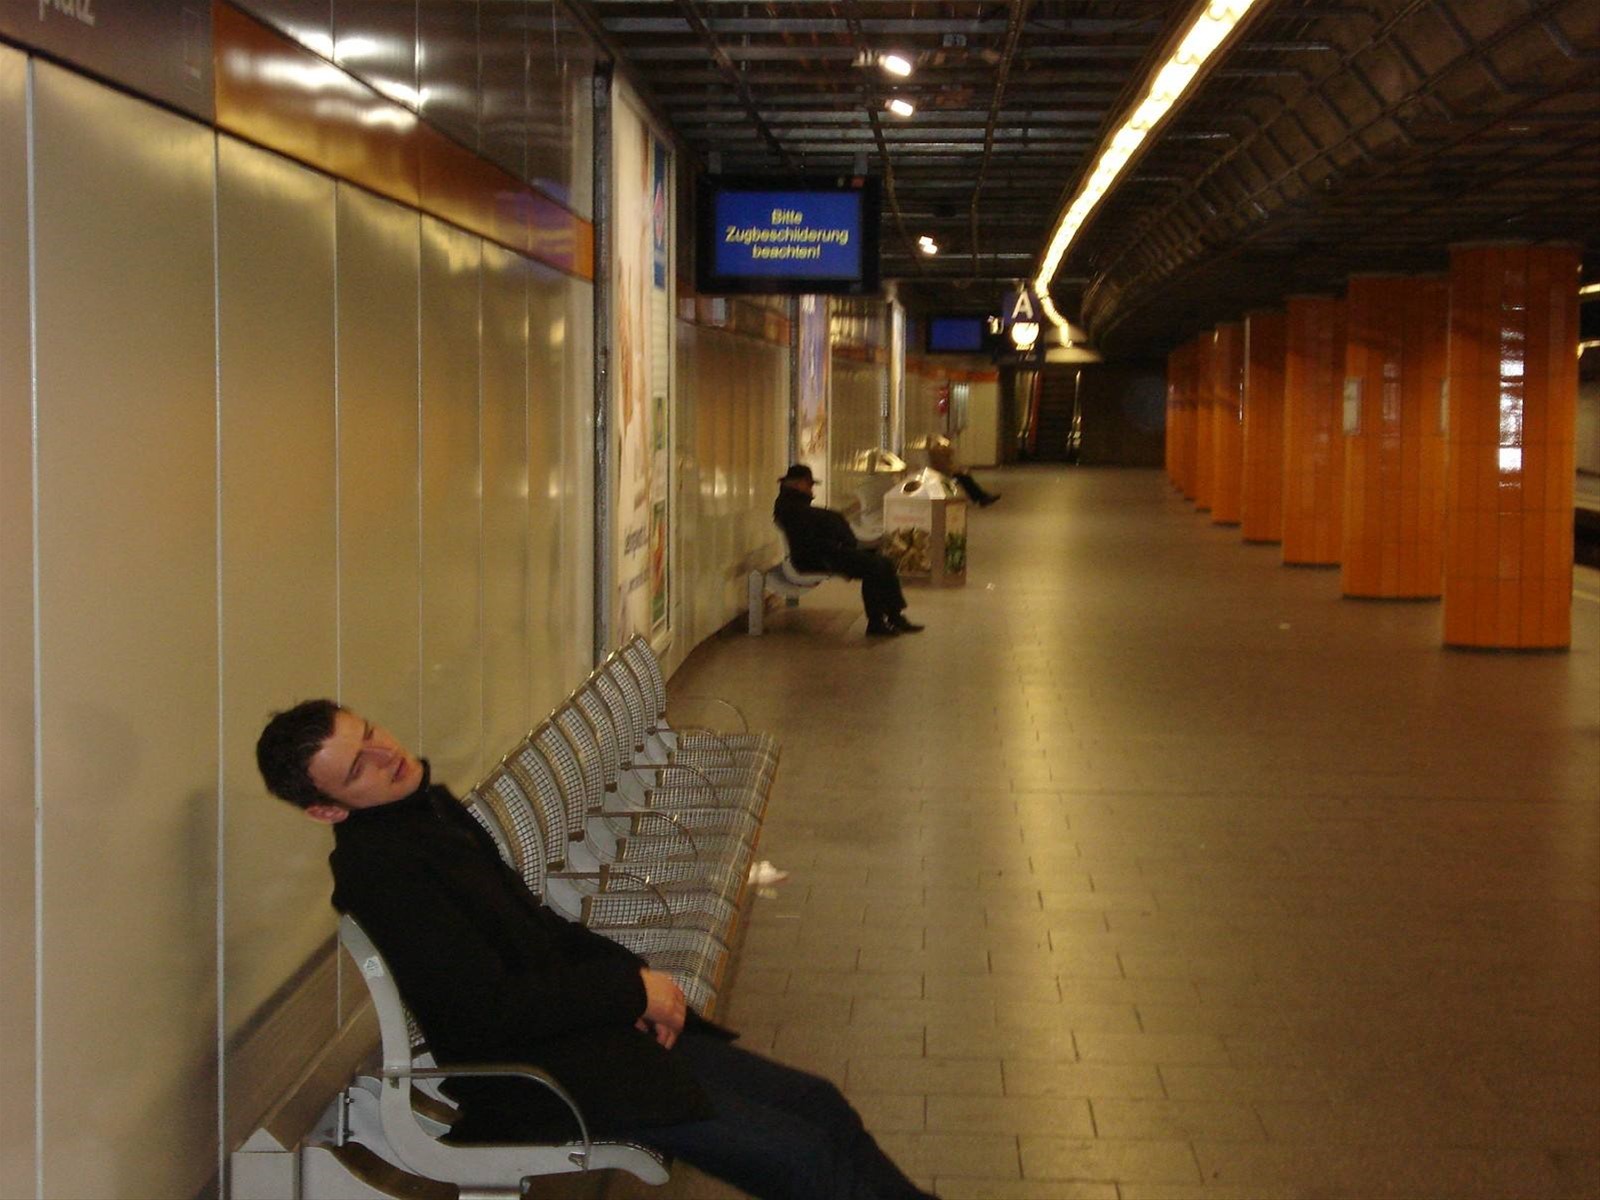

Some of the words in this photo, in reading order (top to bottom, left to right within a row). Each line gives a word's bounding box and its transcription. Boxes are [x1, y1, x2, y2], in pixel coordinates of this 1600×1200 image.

[38, 0, 96, 26] atz
[771, 208, 804, 225] Bitte
[725, 225, 849, 246] Zugbeschilderung
[752, 244, 821, 260] beachten!
[1011, 290, 1035, 320] A
